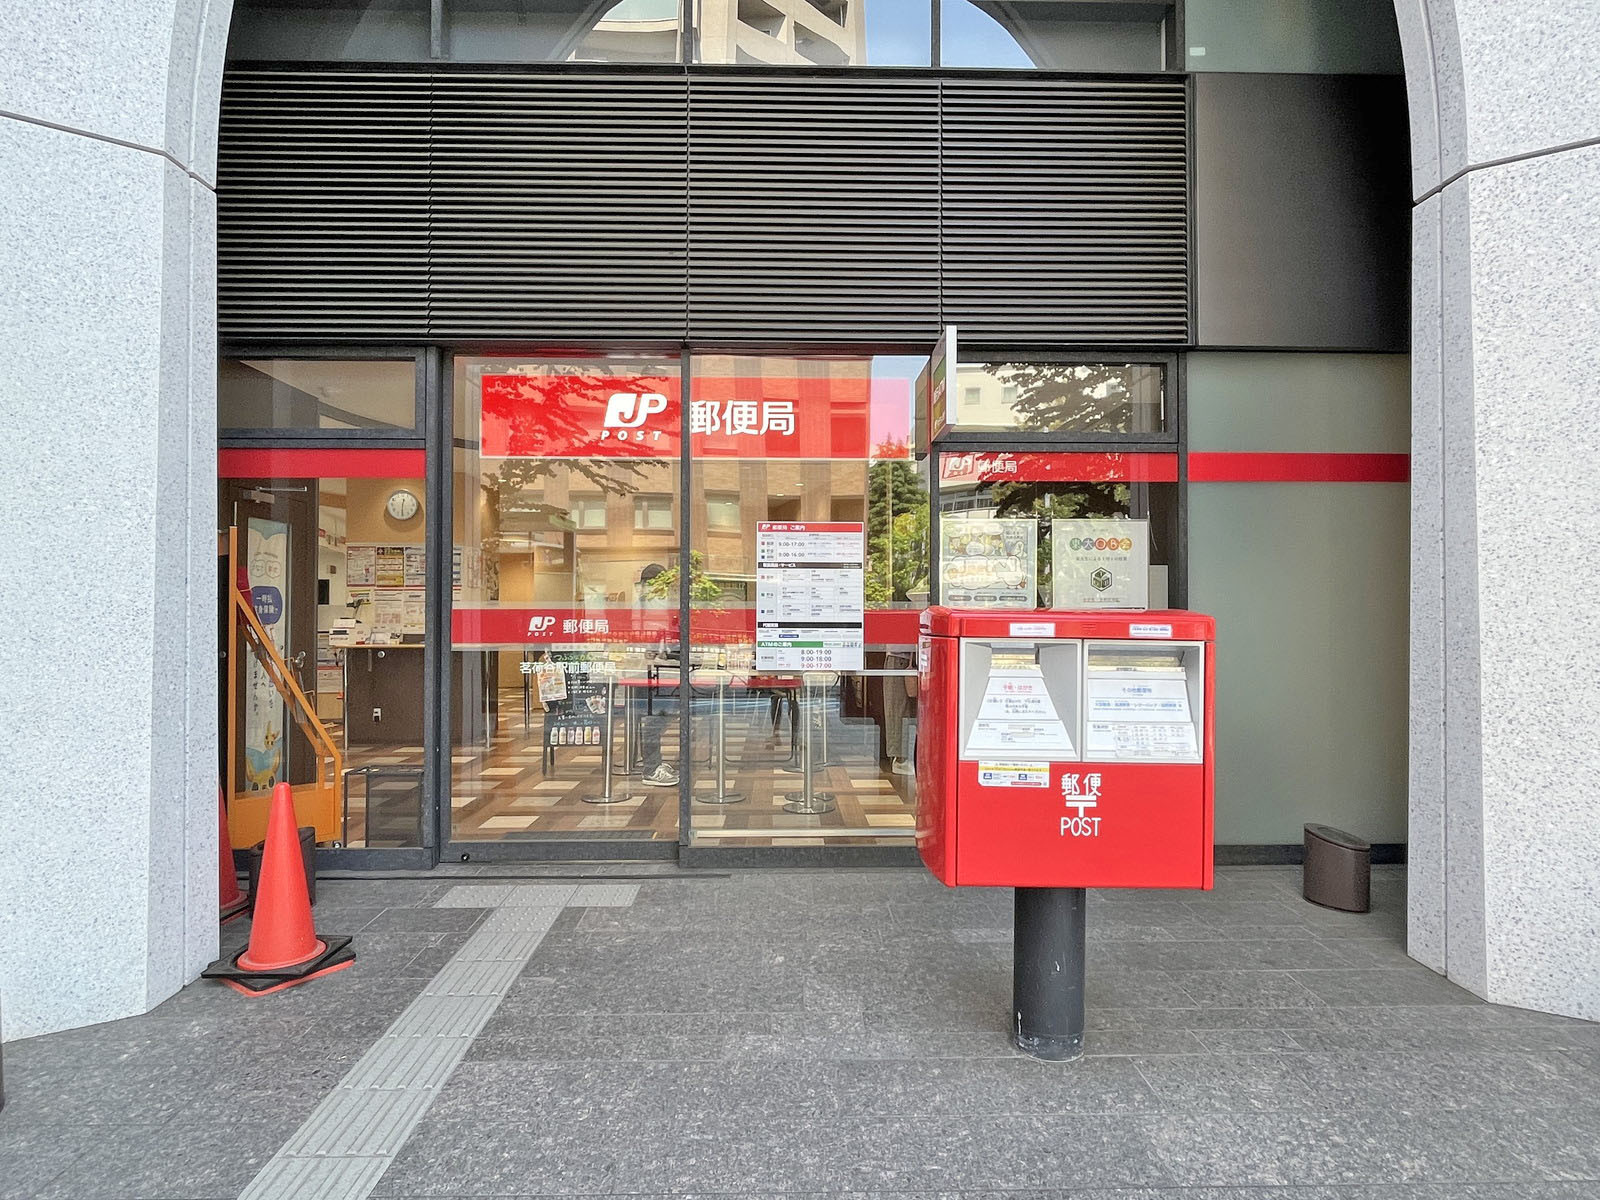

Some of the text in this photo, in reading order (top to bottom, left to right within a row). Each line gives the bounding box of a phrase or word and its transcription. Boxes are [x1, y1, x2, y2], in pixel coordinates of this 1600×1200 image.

[690, 400, 795, 436] 郵便局
[600, 430, 662, 441] POST
[562, 619, 610, 635] 郵便局
[1061, 773, 1102, 797] 郵便
[1060, 817, 1102, 837] POST
